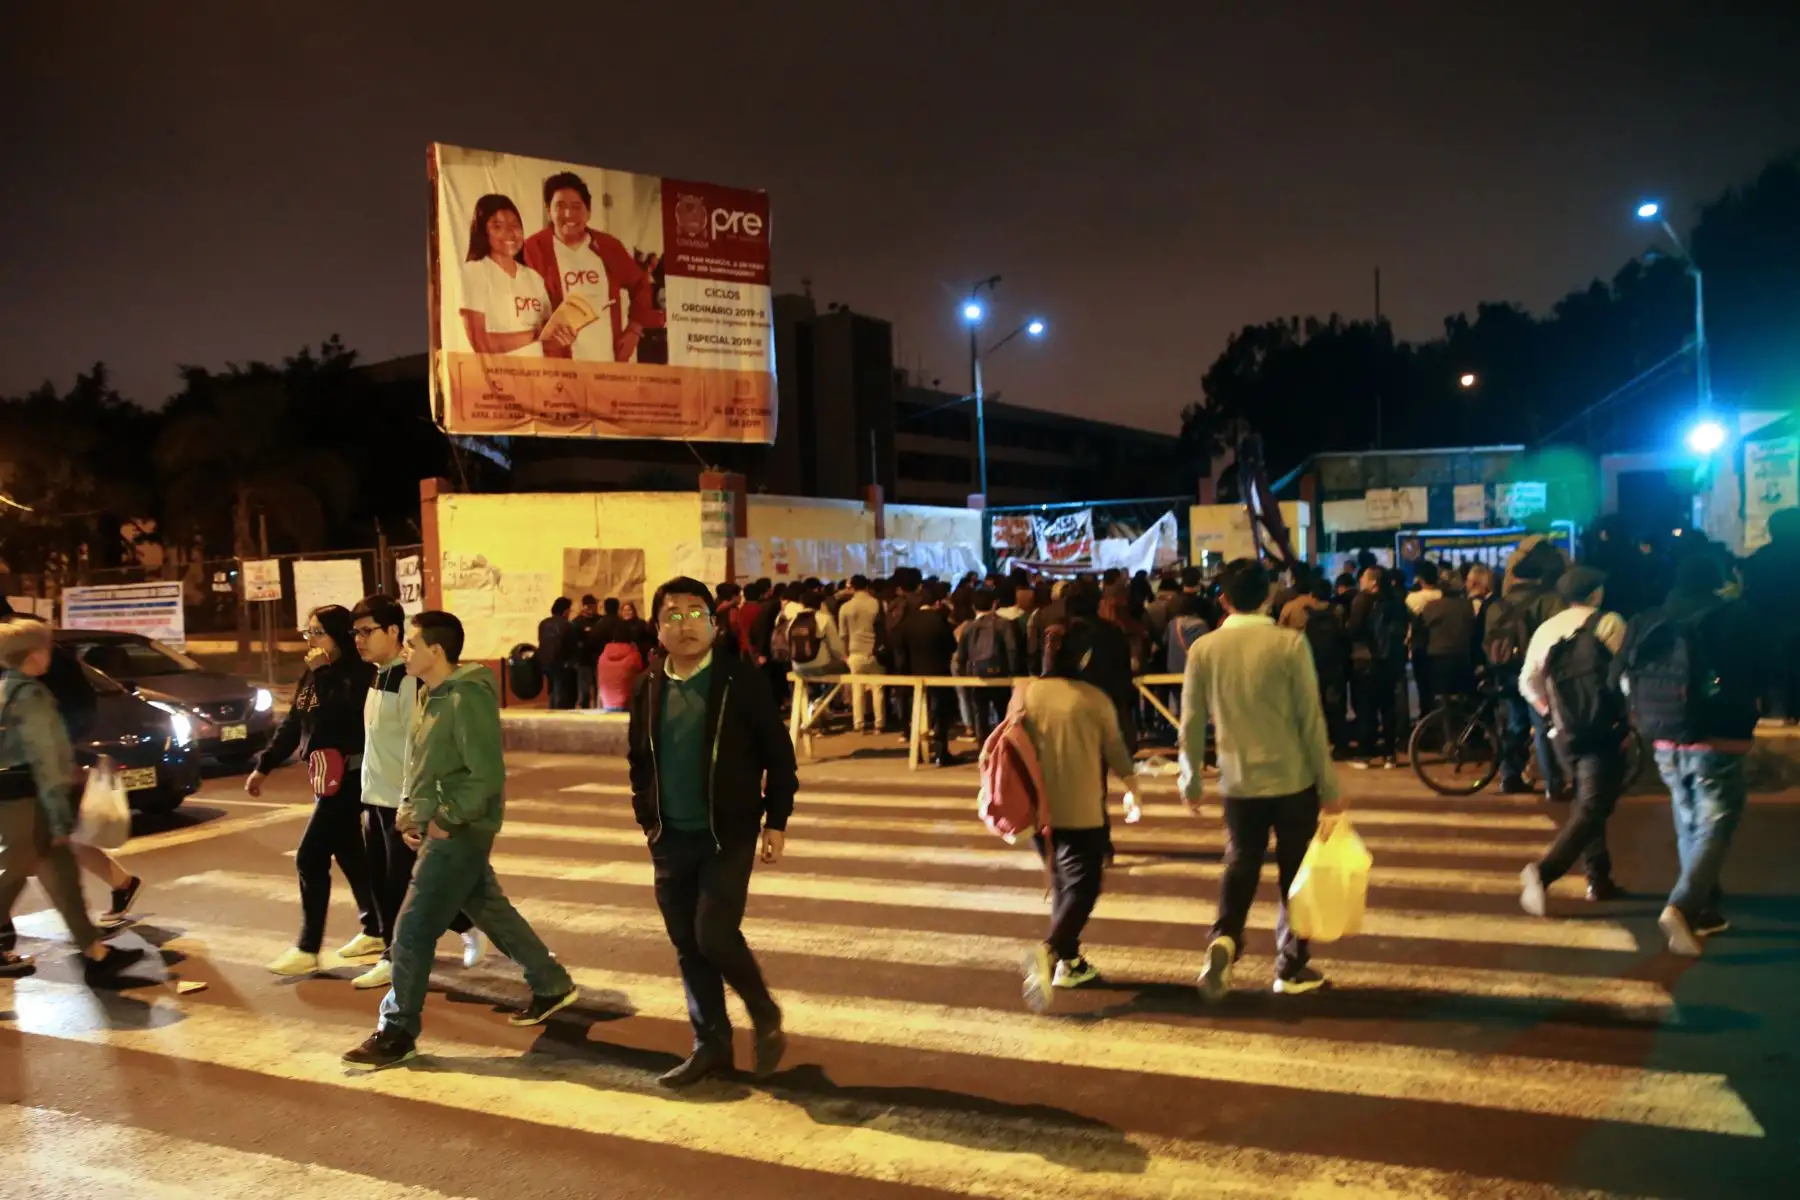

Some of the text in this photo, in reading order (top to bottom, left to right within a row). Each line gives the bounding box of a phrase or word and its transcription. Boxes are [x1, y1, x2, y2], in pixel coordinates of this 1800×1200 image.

[711, 208, 763, 240] pre
[564, 270, 599, 293] pre
[704, 288, 741, 300] CICLOS
[515, 296, 541, 317] pre
[688, 333, 729, 344] ESPECIAL
